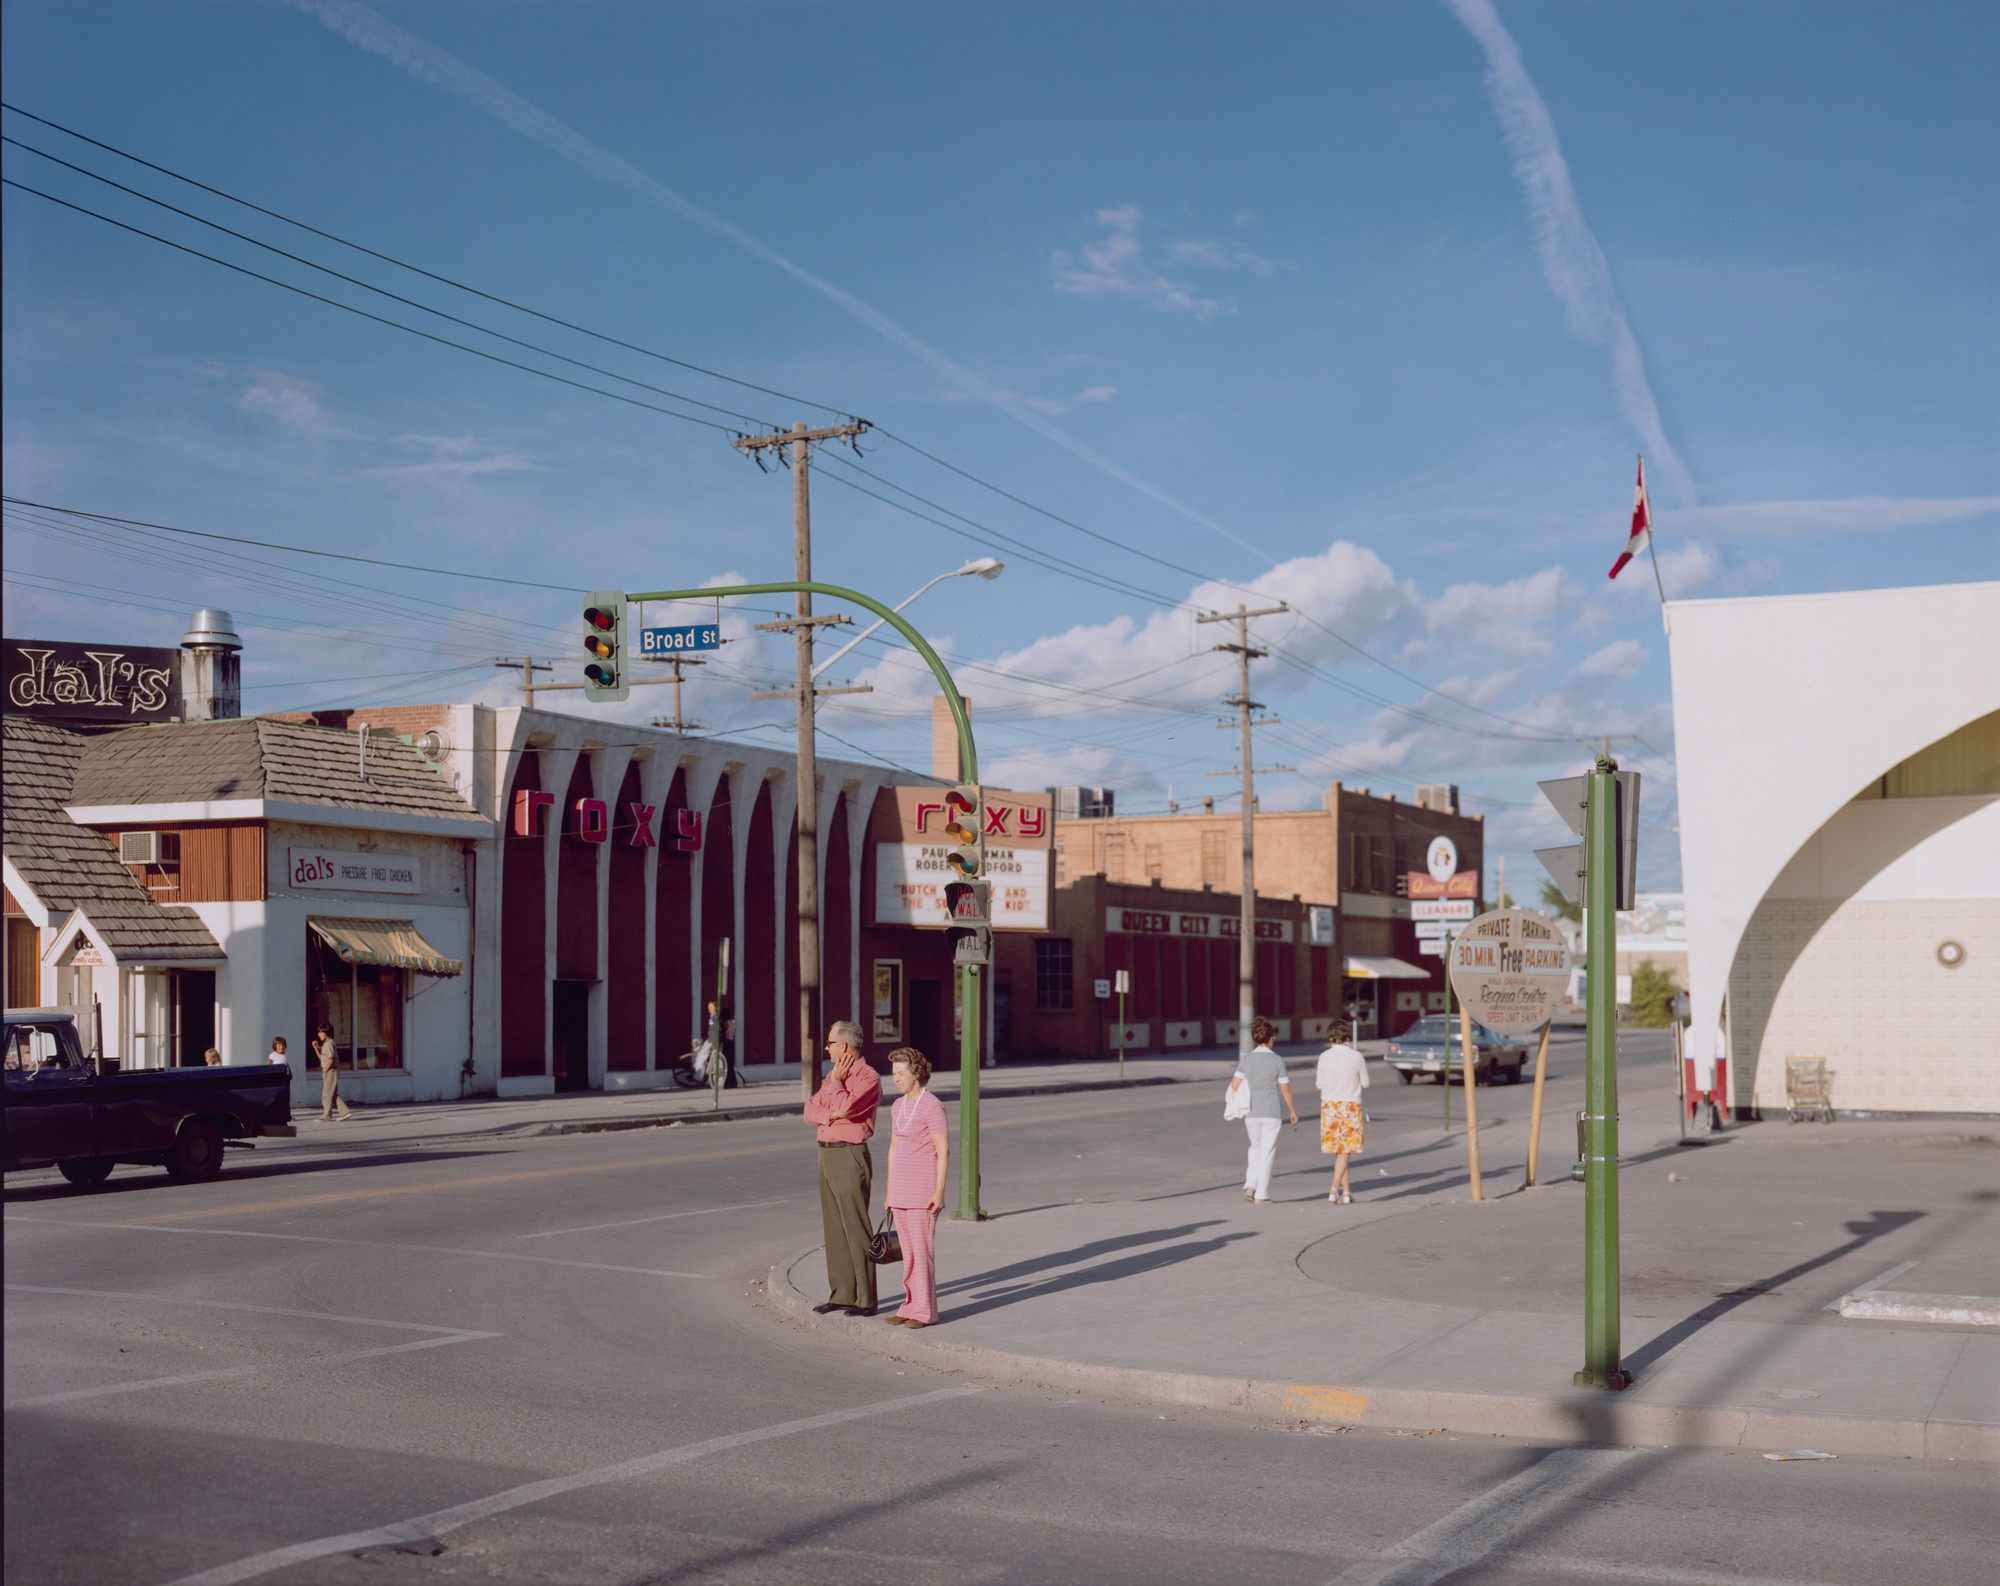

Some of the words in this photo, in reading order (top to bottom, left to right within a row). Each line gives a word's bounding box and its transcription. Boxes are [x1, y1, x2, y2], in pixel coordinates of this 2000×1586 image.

[644, 628, 695, 650] Broad
[702, 630, 716, 644] St
[10, 649, 169, 714] dal's
[514, 789, 702, 851] roxy
[915, 802, 1045, 837] rxy
[295, 856, 334, 883] dal's
[341, 866, 367, 880] PRESSURE
[371, 867, 387, 881] FRIED
[389, 869, 413, 882] CHICKEN
[986, 862, 1022, 873] DFORD
[902, 898, 922, 908] THE
[1005, 887, 1027, 898] AND
[1415, 904, 1470, 915] CLEANERS
[1122, 911, 1170, 933] QUEEN
[1180, 915, 1210, 934] CITY
[1219, 918, 1282, 938] CLENERS
[1477, 918, 1510, 937] PRIVATE
[1521, 919, 1551, 939] PARKING
[959, 936, 982, 950] WAL
[1459, 946, 1472, 966] 30
[1474, 947, 1496, 967] MIN.
[1499, 941, 1523, 973] Free
[1525, 949, 1565, 969] PARKING
[1480, 984, 1516, 1008] Regina
[1517, 987, 1547, 1003] Centre
